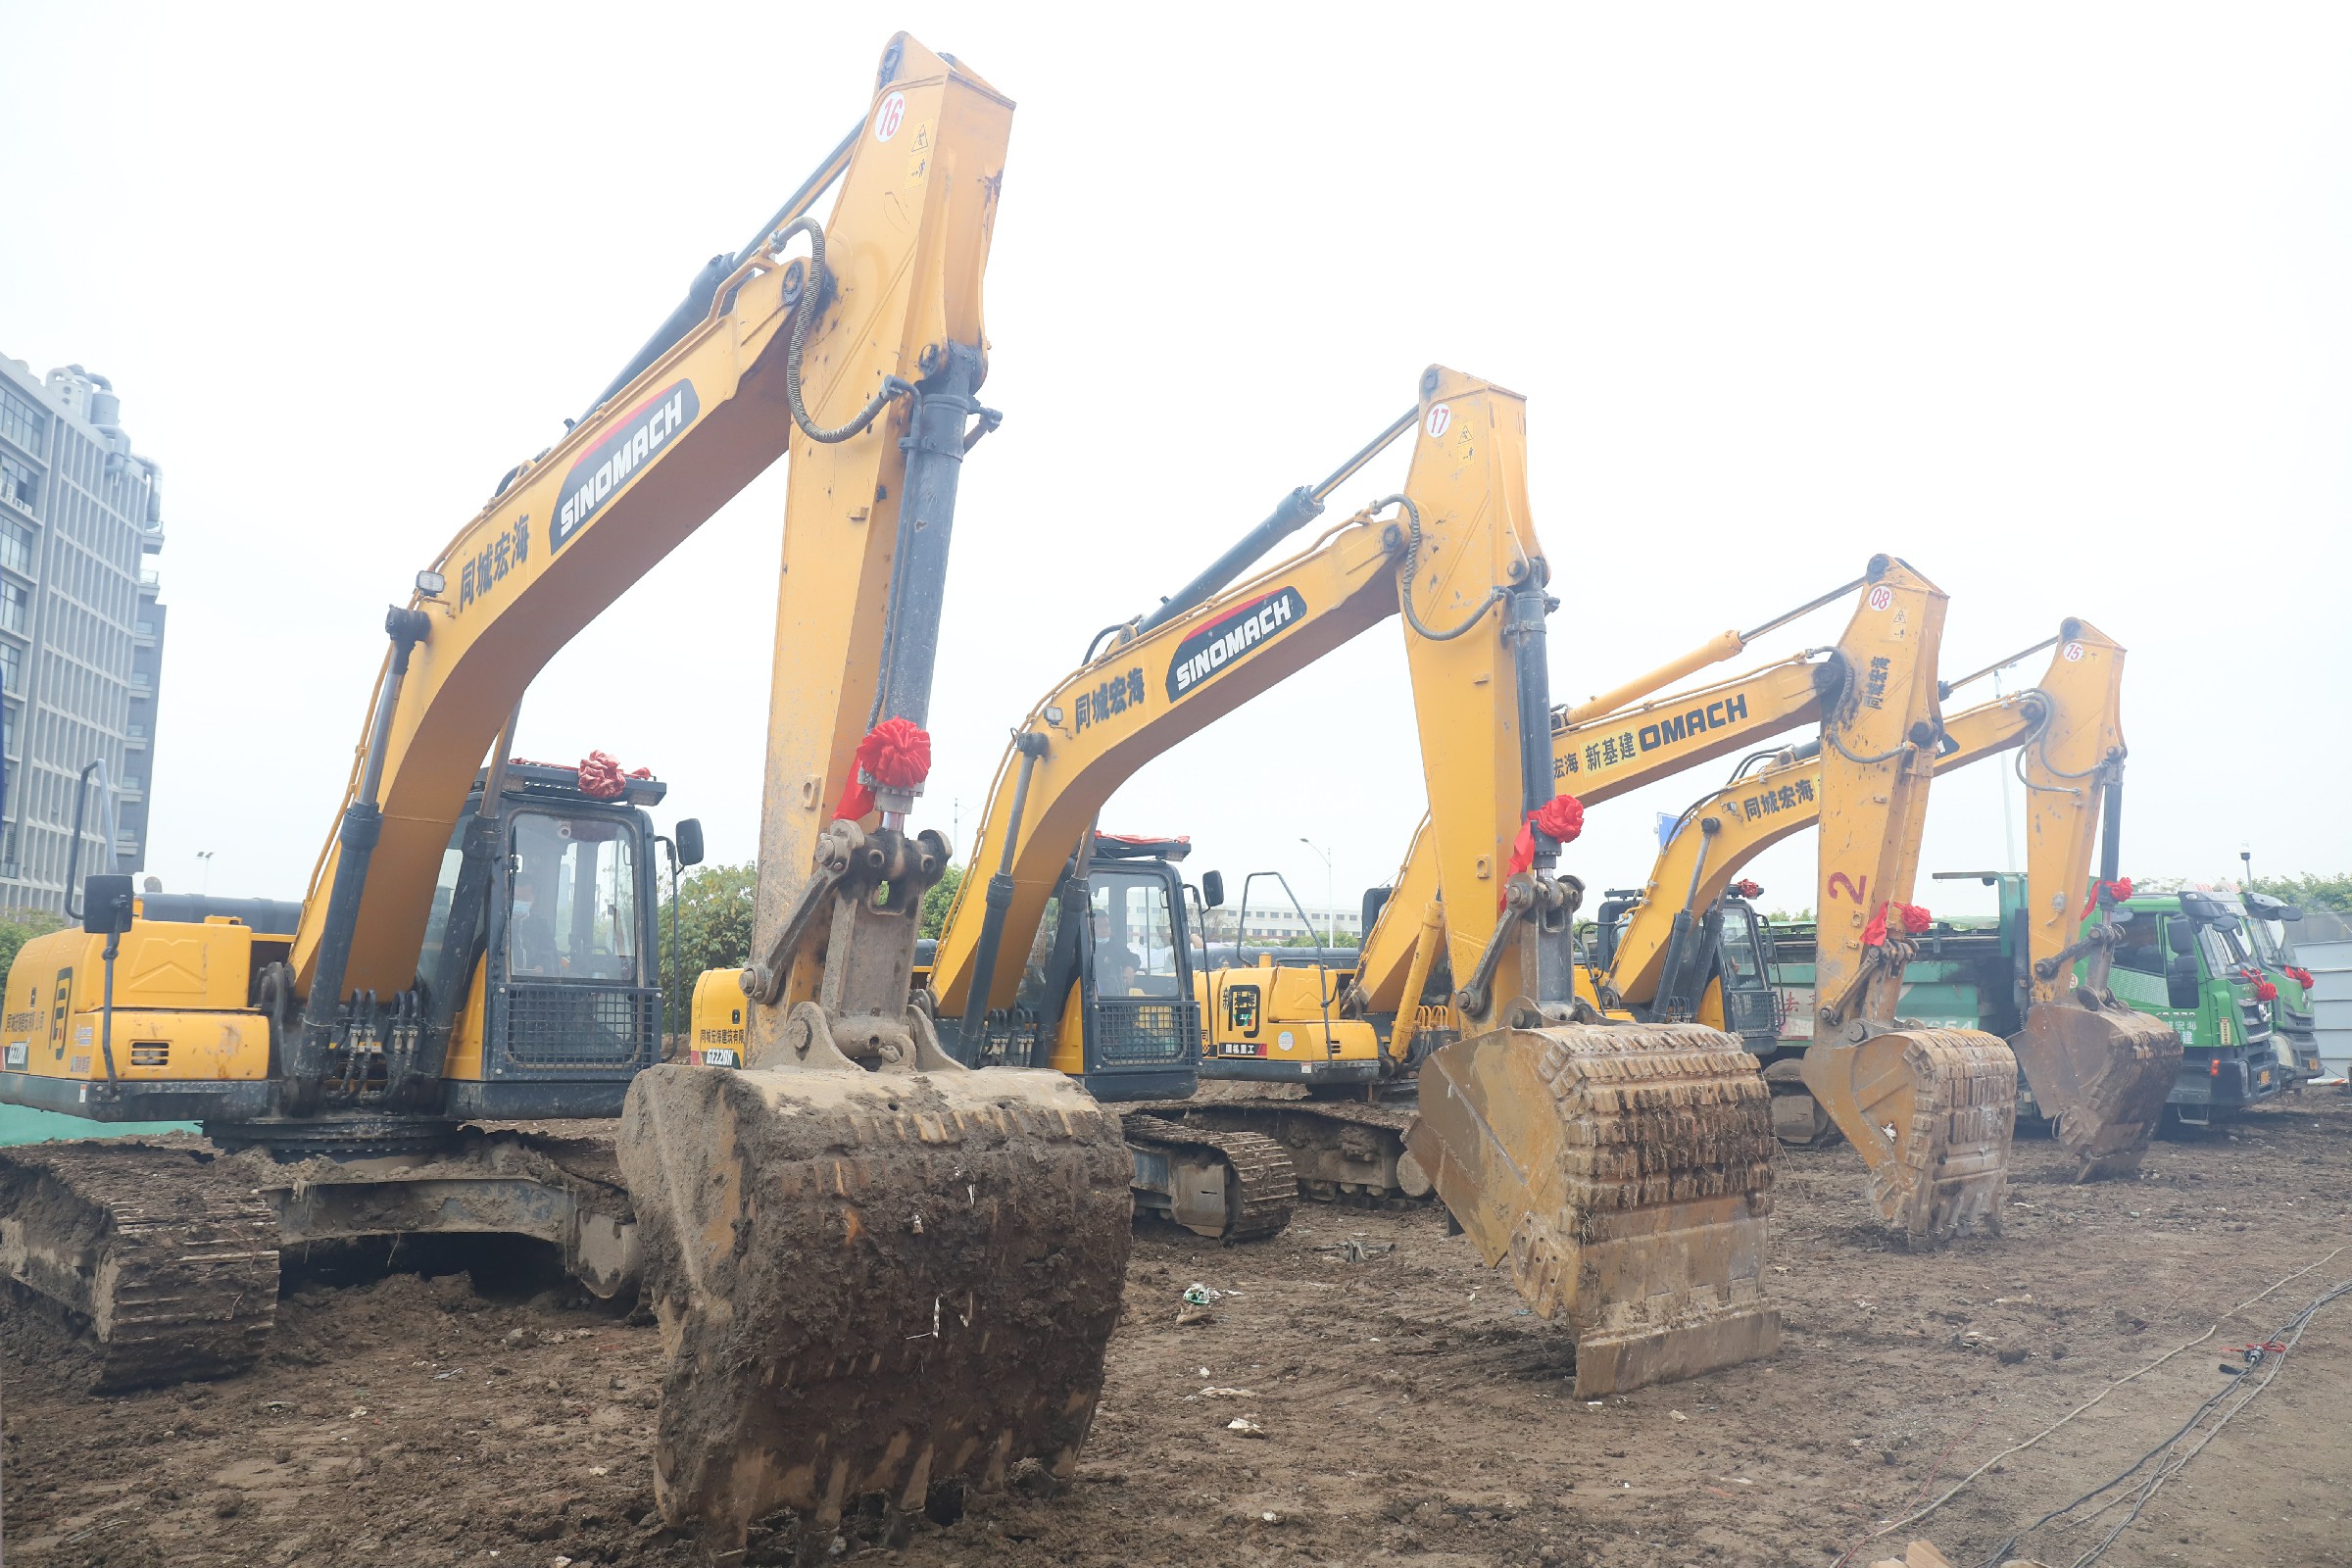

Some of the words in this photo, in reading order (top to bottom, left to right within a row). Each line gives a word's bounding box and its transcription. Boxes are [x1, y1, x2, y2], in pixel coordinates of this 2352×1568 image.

[879, 98, 904, 137] 16
[1431, 408, 1449, 434] 17
[561, 389, 682, 537] SINOMACH
[460, 514, 530, 613] 同城宏海
[1871, 587, 1890, 611] 08
[1176, 594, 1292, 692] SINOMACH
[2066, 644, 2082, 661] 15
[1075, 667, 1145, 734] 同城宏海
[1863, 656, 1891, 710] 同城宏海
[1585, 732, 1637, 772] 新基建
[1639, 693, 1748, 753] OMACH
[1743, 779, 1815, 822] 同城宏海
[1827, 871, 1867, 906] 2
